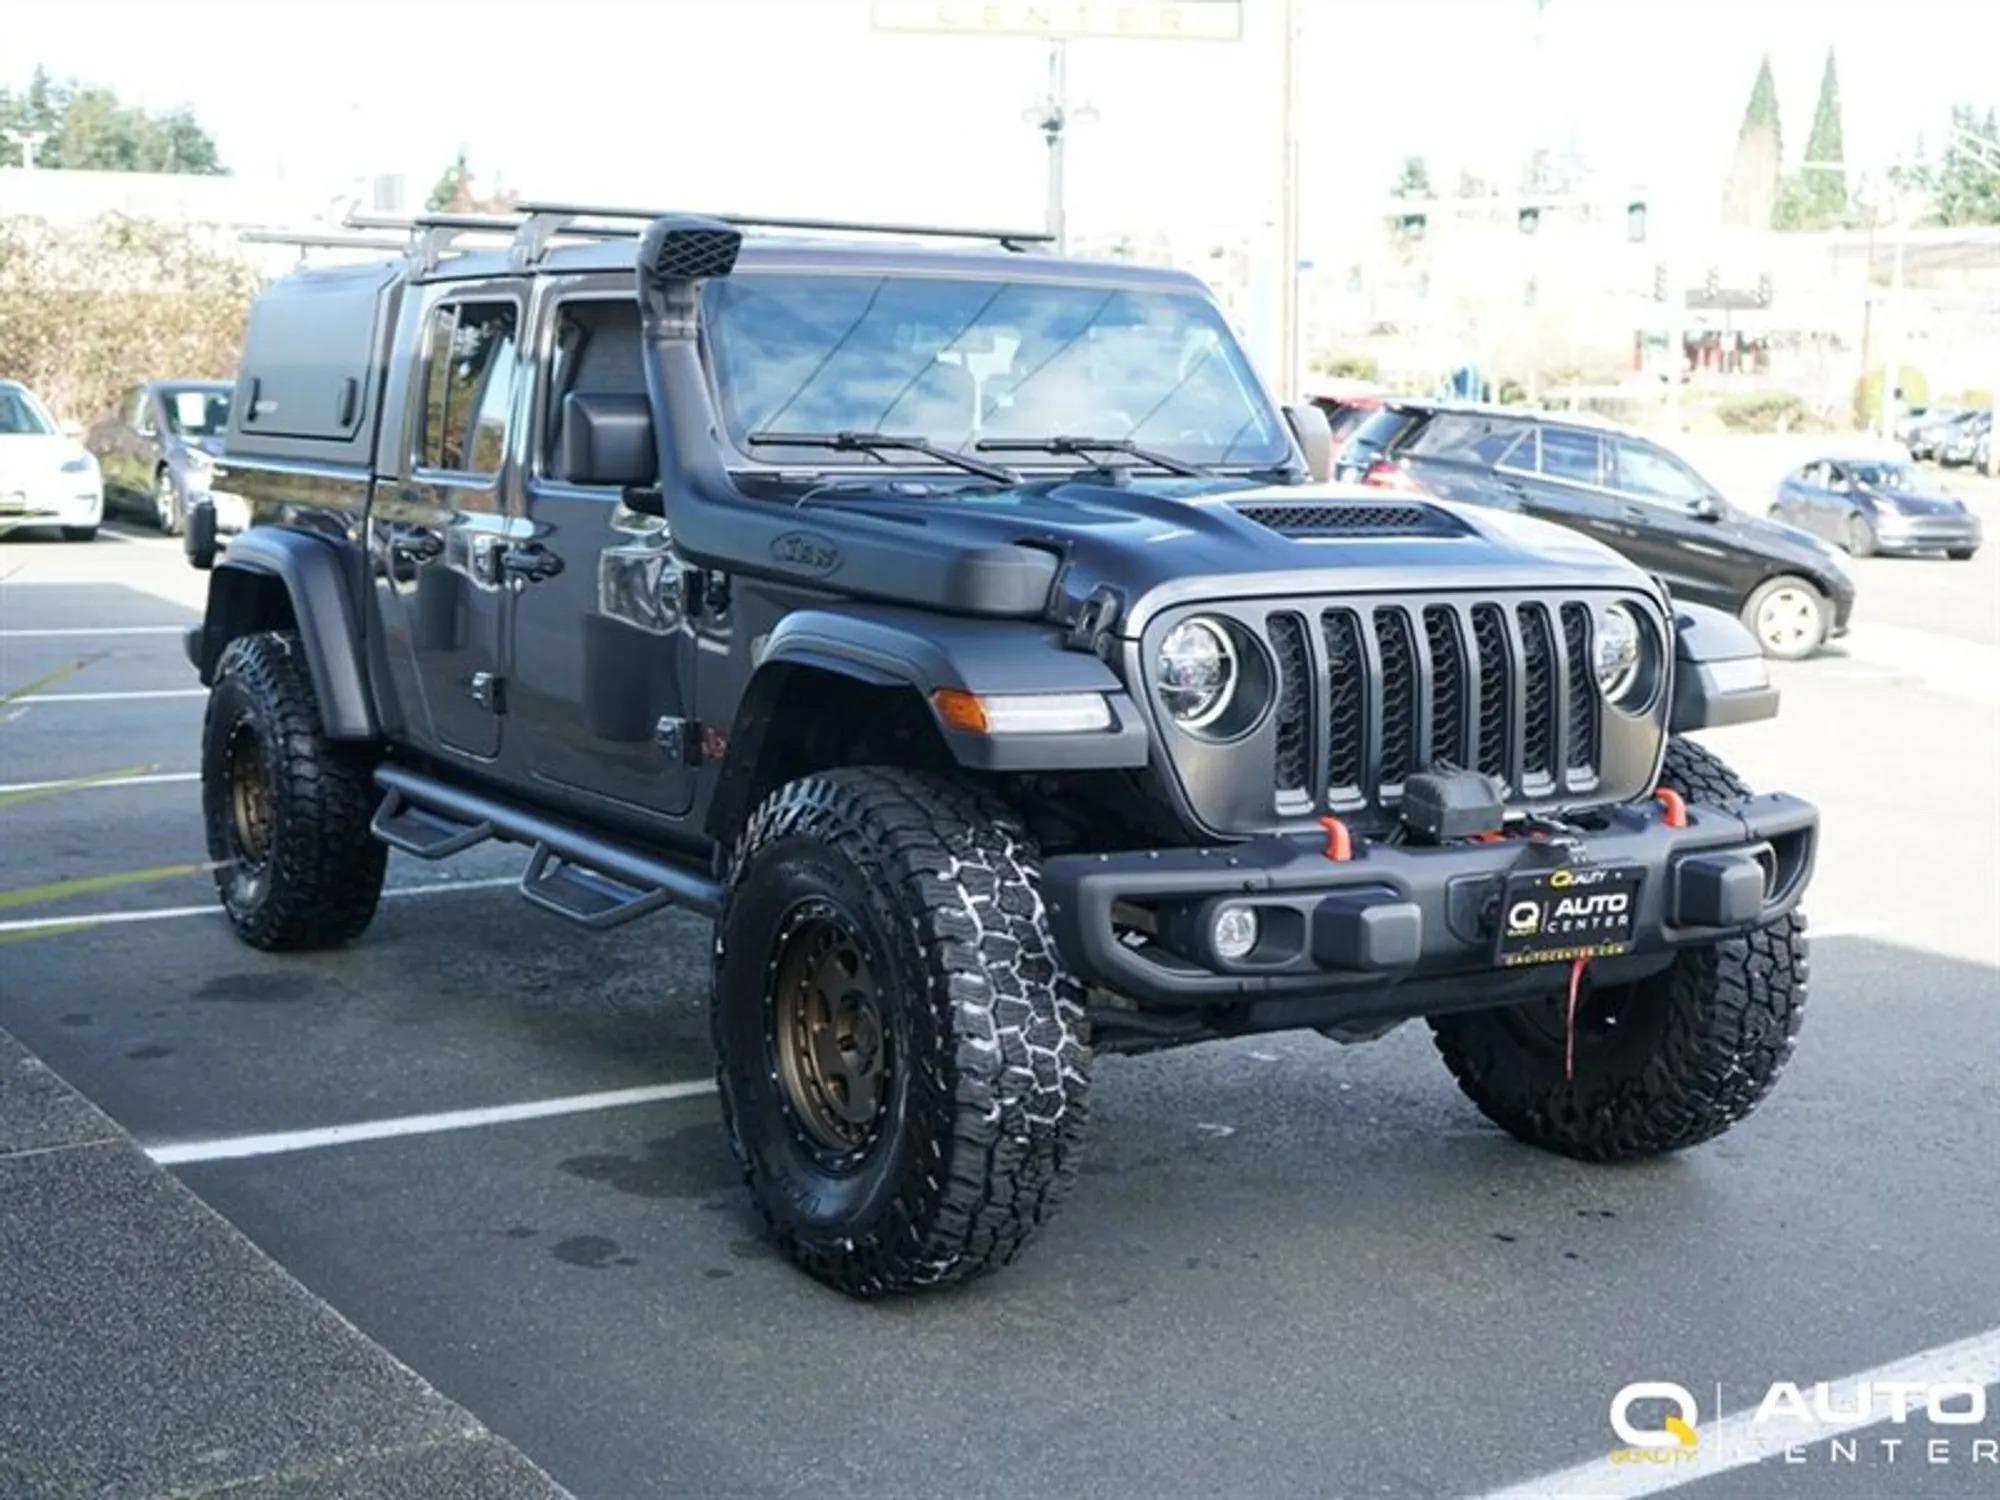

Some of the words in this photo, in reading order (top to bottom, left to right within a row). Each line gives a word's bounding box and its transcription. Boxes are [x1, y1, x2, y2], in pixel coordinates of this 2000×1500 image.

[1509, 901, 1539, 928] Q
[1555, 894, 1628, 917] AUTO
[1547, 914, 1628, 934] CENTER
